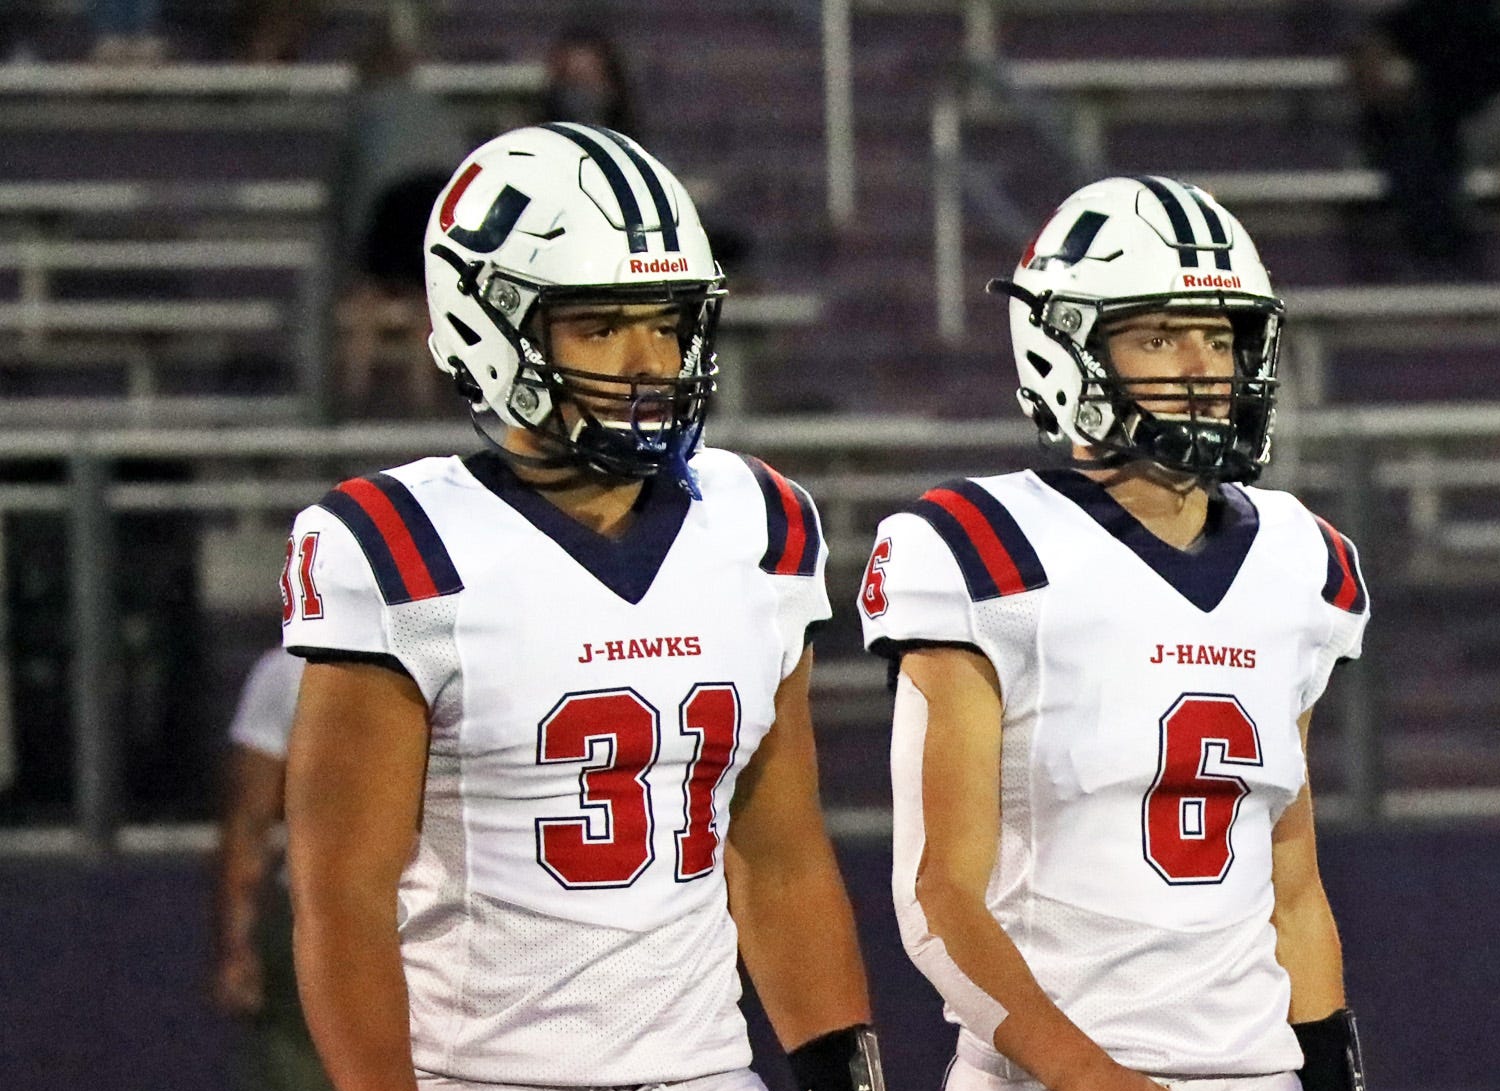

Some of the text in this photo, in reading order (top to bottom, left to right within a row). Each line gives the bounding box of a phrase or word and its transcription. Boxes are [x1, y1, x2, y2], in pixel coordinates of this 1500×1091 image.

[439, 162, 532, 254] U
[630, 258, 688, 273] Riddell
[1183, 275, 1241, 288] Riddell
[860, 536, 892, 620] 6
[578, 636, 701, 663] J-HAWKS
[1150, 644, 1256, 669] J-HAWKS
[535, 681, 741, 890] 31
[1141, 691, 1263, 886] 6
